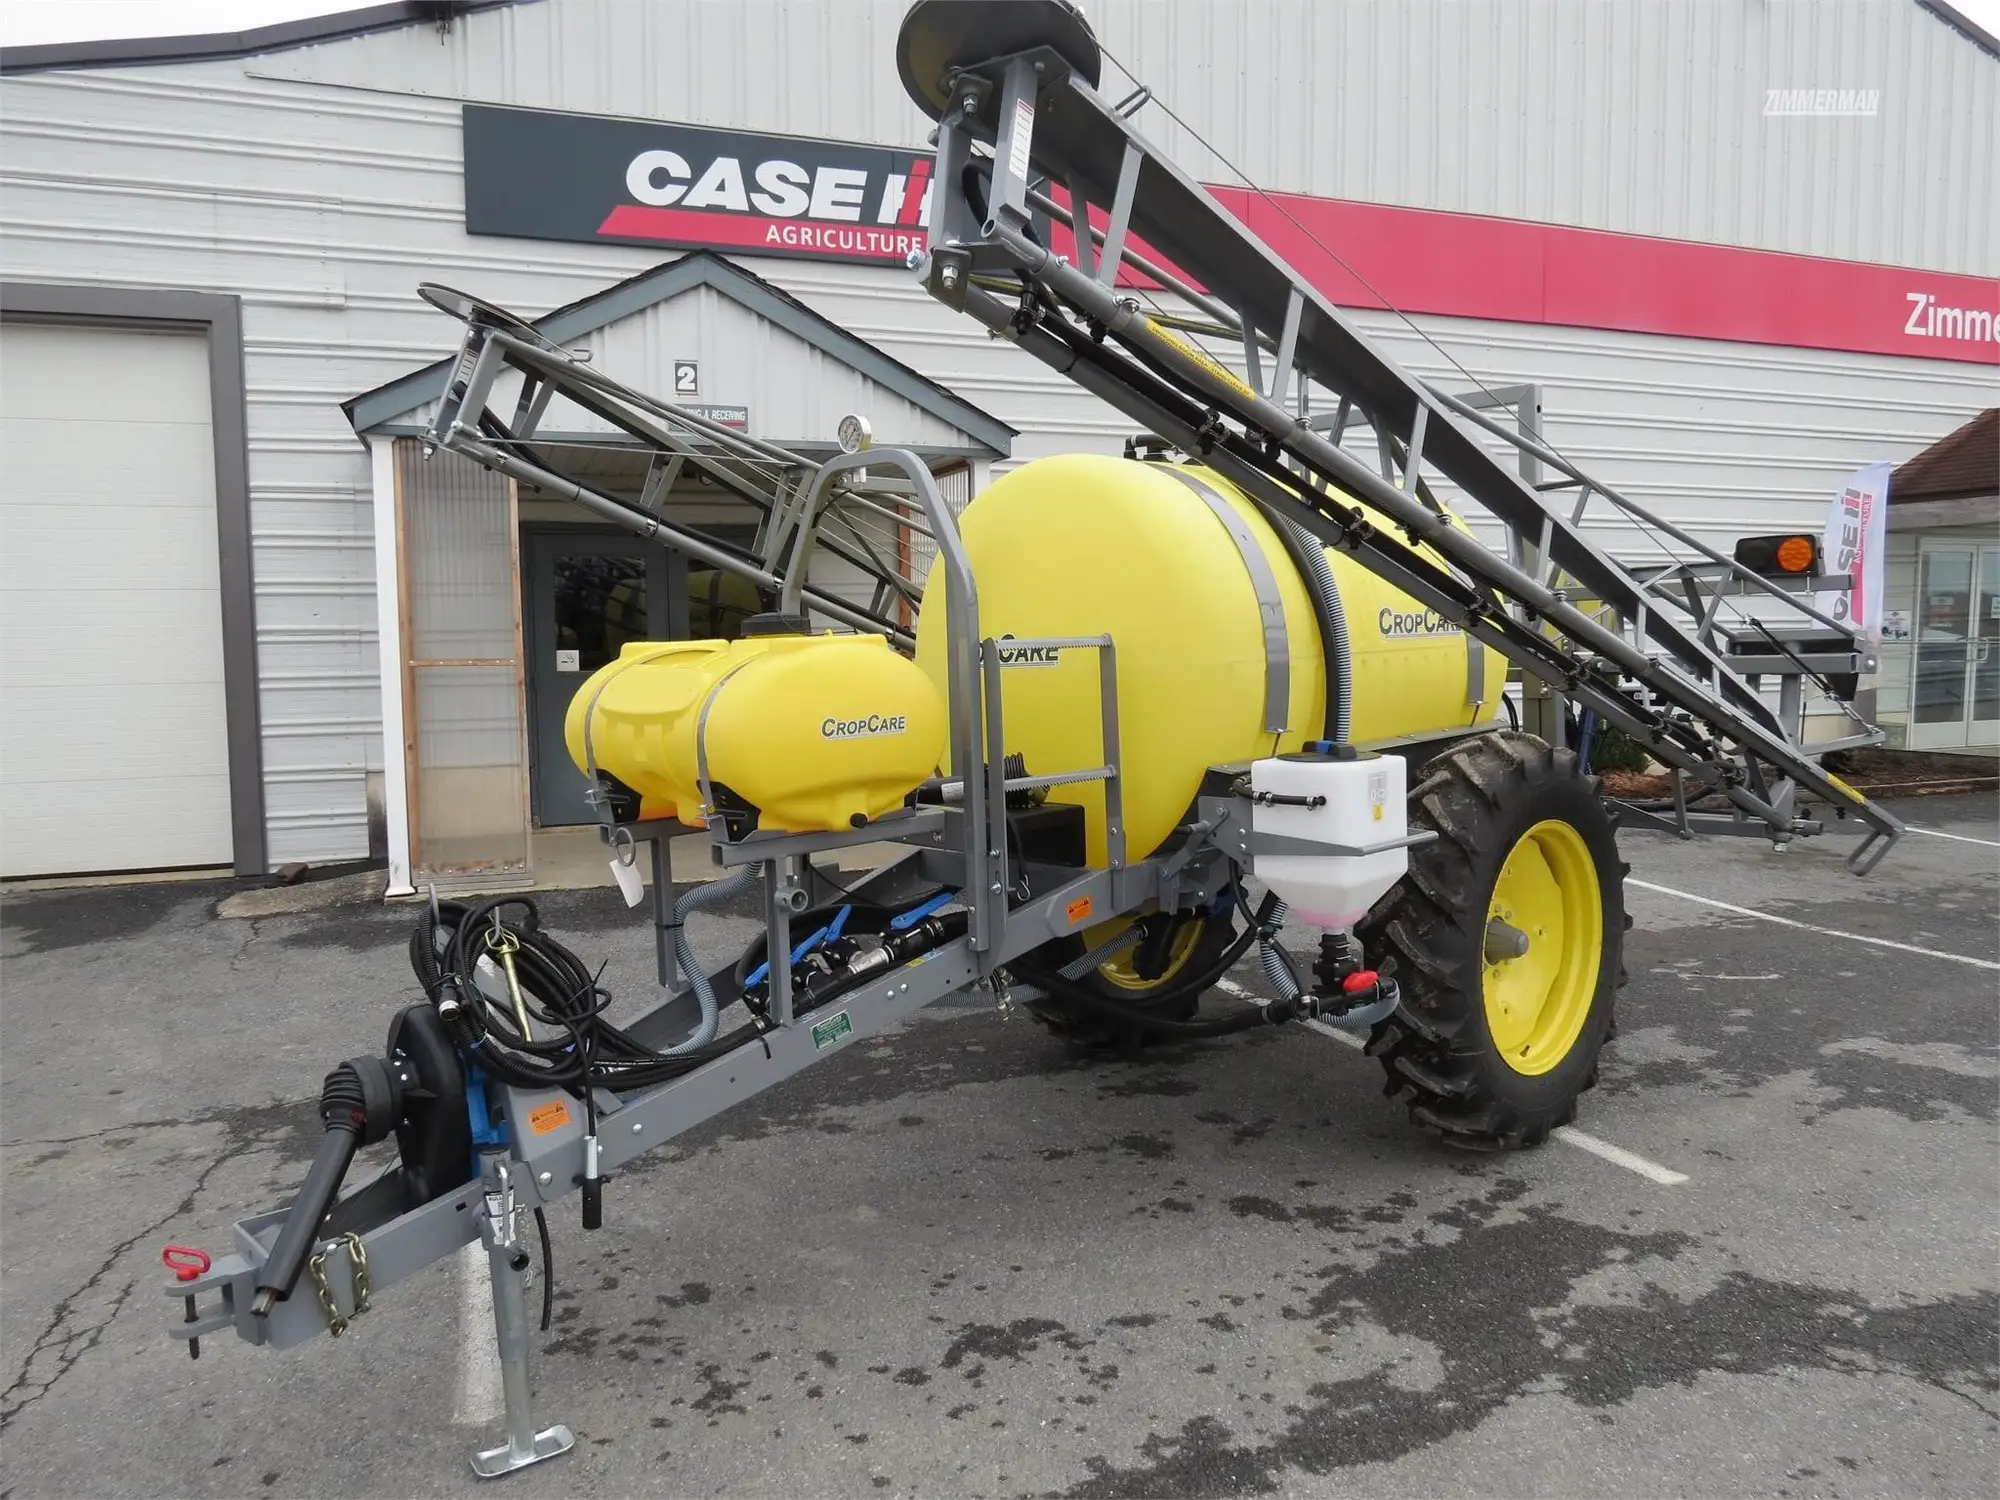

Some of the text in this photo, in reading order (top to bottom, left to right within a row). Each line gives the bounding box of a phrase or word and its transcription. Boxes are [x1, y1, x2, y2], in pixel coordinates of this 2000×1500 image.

[626, 150, 867, 222] CASE
[766, 224, 924, 254] AGRICULTURE
[677, 366, 696, 391] 2
[1833, 523, 1858, 621] CSE
